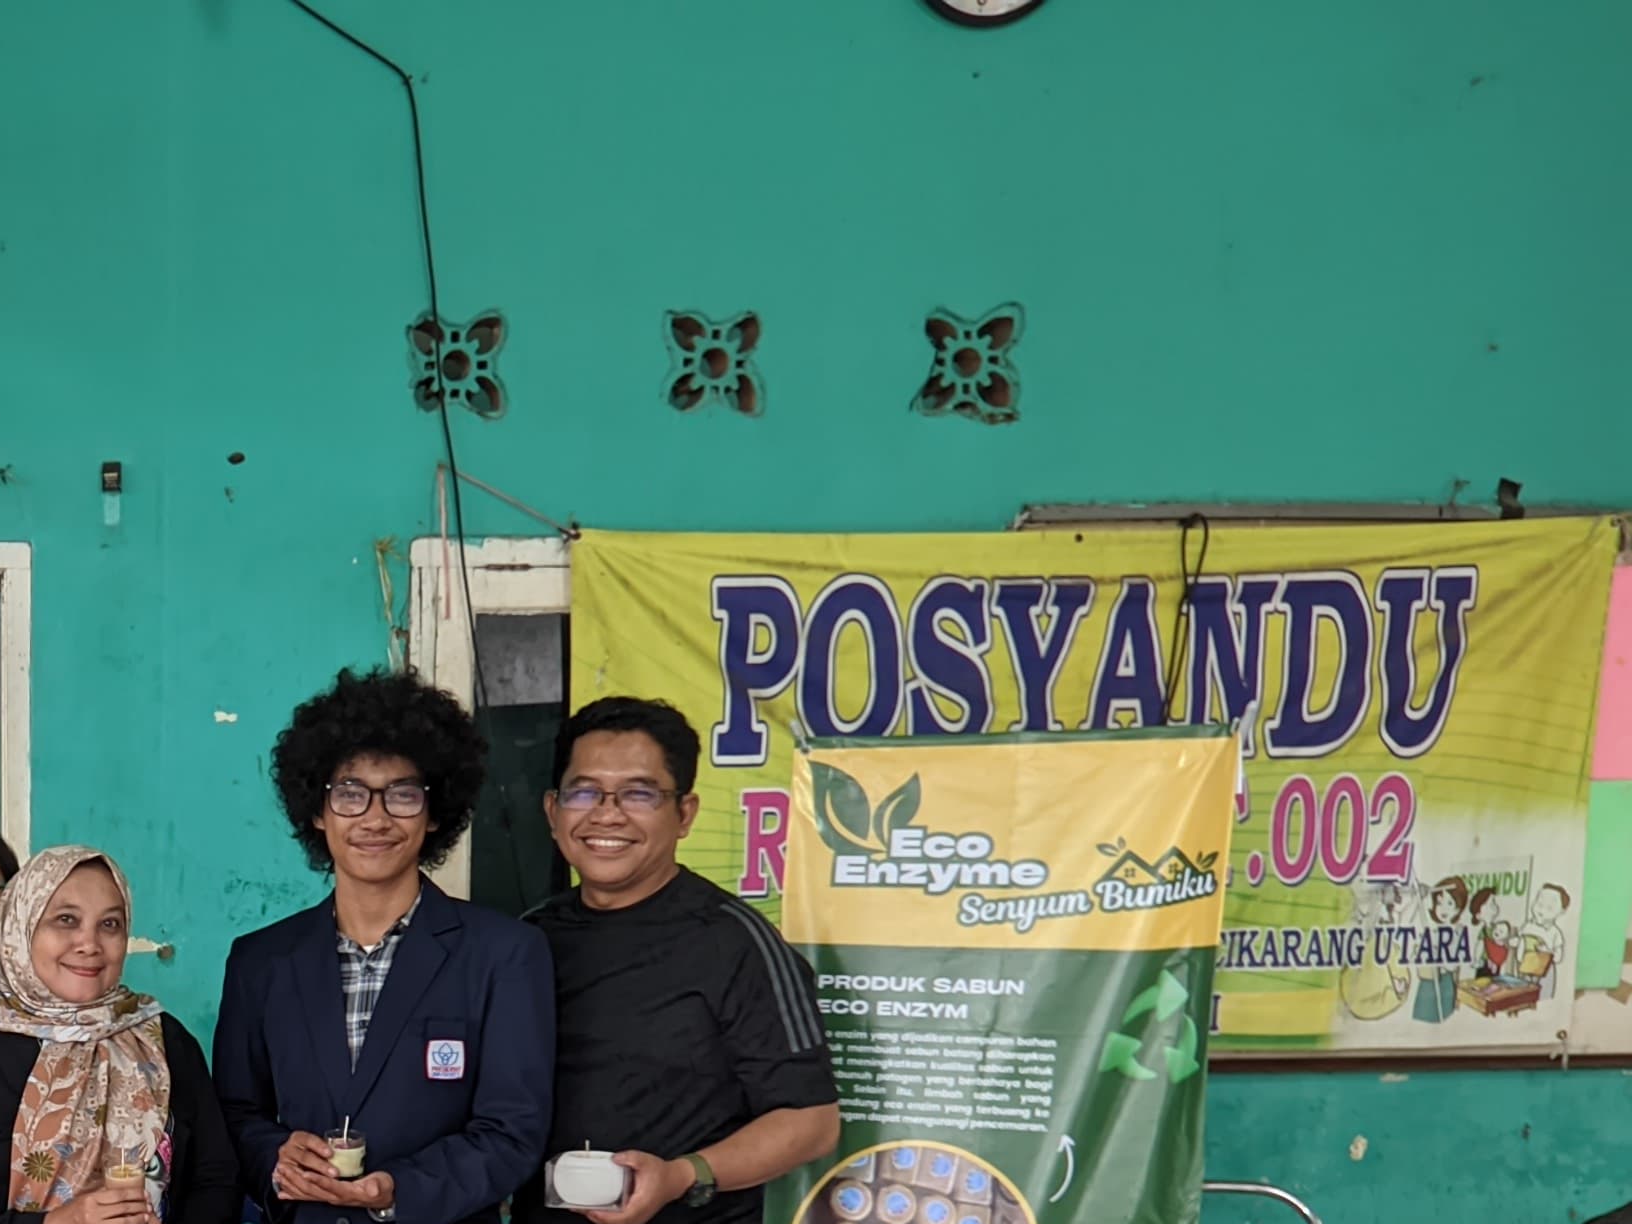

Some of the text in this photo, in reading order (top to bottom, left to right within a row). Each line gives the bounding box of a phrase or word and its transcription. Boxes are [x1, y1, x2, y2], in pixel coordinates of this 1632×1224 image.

[709, 565, 1478, 768] POSYANDU
[889, 828, 991, 859] Eco
[1237, 772, 1416, 884] .002
[834, 855, 1048, 893] Enzyme
[958, 866, 1218, 932] Senyum Bumiku
[1374, 926, 1472, 964] UTARA
[818, 975, 1025, 995] PRODUK SABUN
[818, 998, 968, 1019] ECO ENZYM
